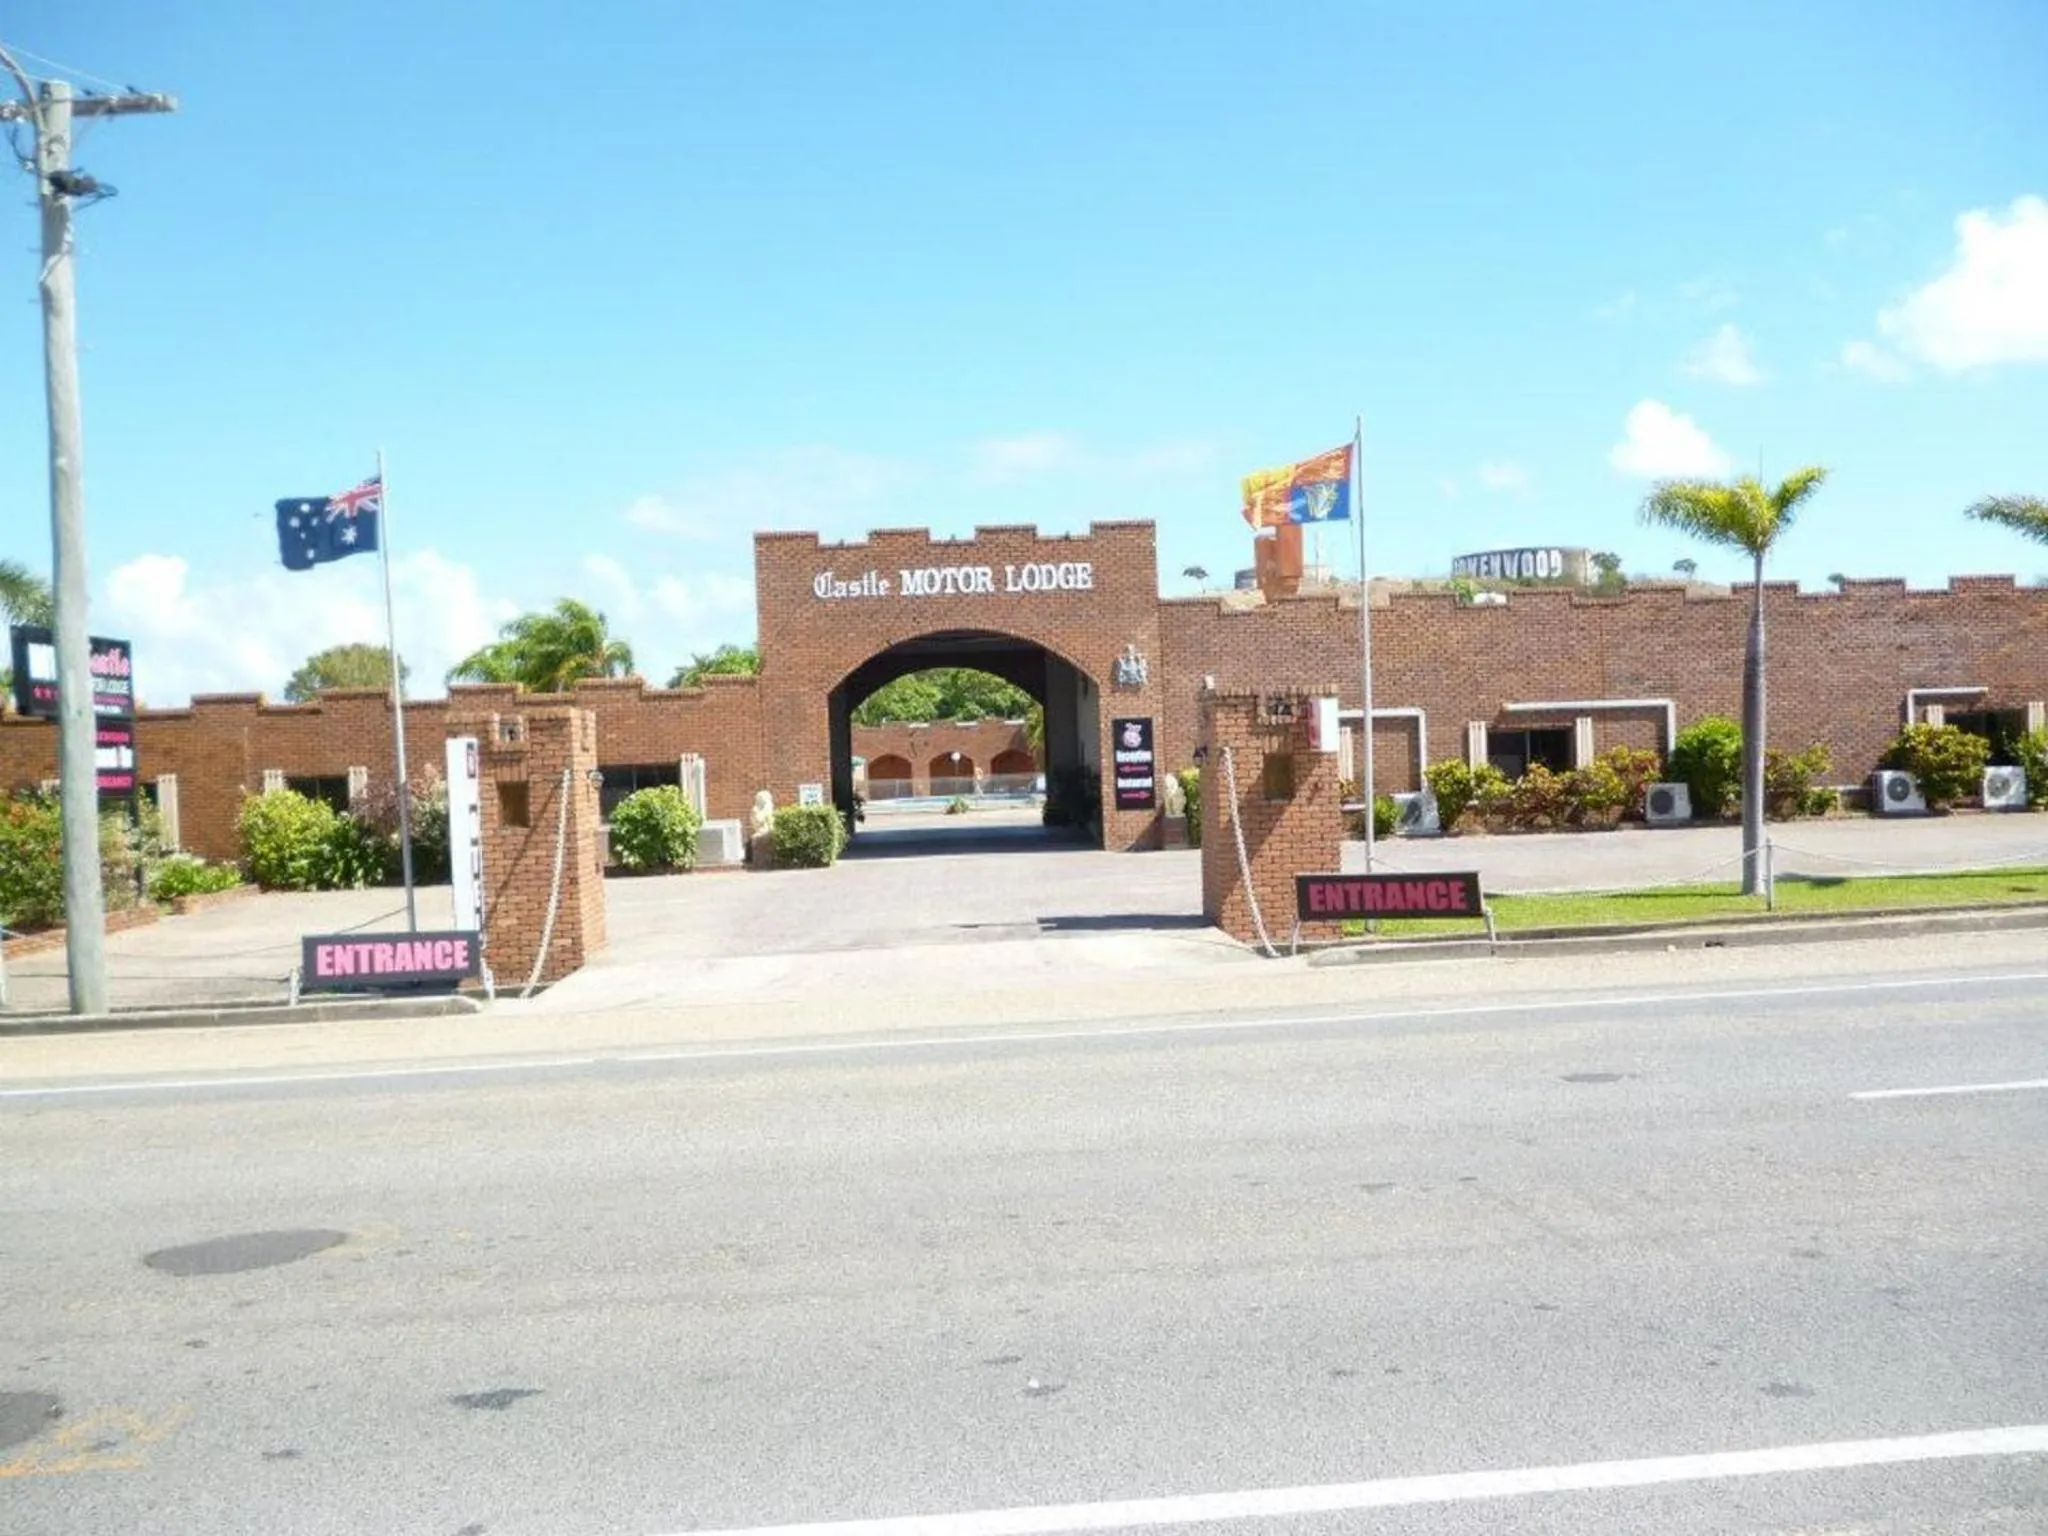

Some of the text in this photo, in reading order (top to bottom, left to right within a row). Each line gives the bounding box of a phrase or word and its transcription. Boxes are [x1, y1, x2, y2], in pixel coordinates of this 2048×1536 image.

[814, 562, 1093, 598] Castle MOTOR LODGE
[1308, 880, 1467, 912] ENTRANCE
[316, 940, 469, 976] ENTRANCE
